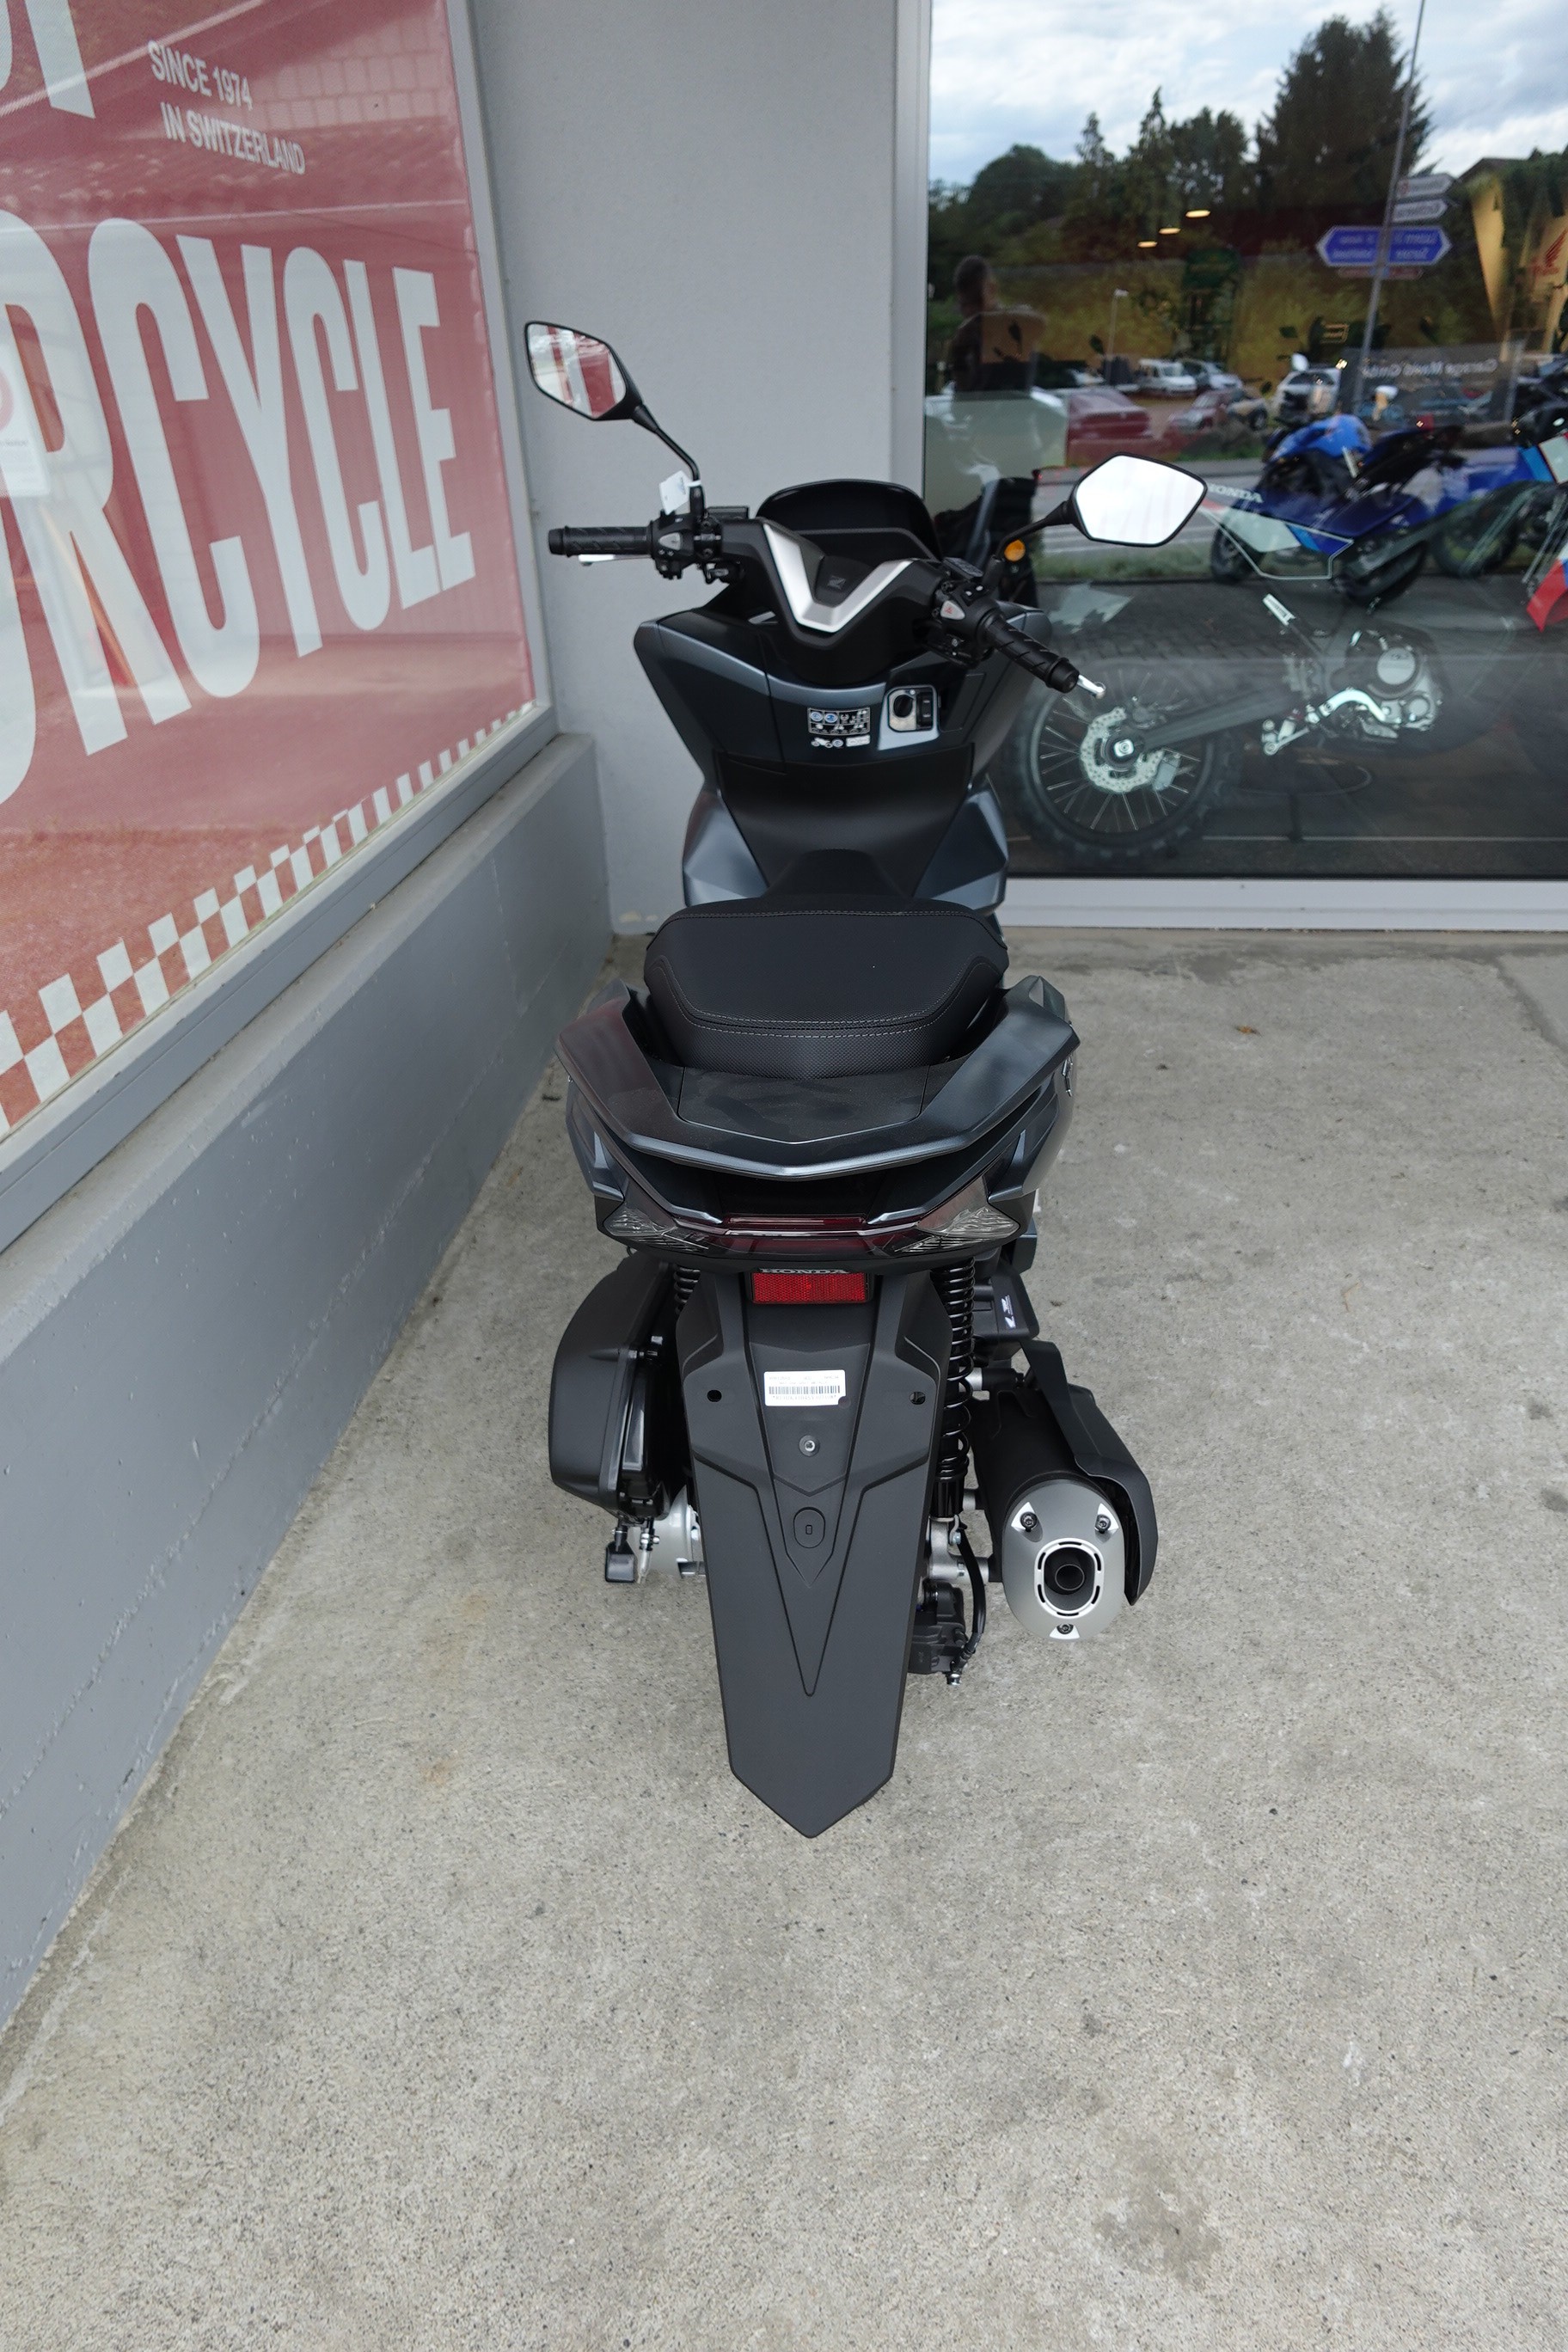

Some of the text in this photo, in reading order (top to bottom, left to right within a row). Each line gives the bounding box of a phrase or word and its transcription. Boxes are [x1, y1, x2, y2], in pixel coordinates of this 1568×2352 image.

[148, 40, 212, 97] SINCE
[212, 66, 254, 111] 1974
[160, 101, 305, 175] IN SWITZERLAND
[0, 210, 475, 805] RCYCLE
